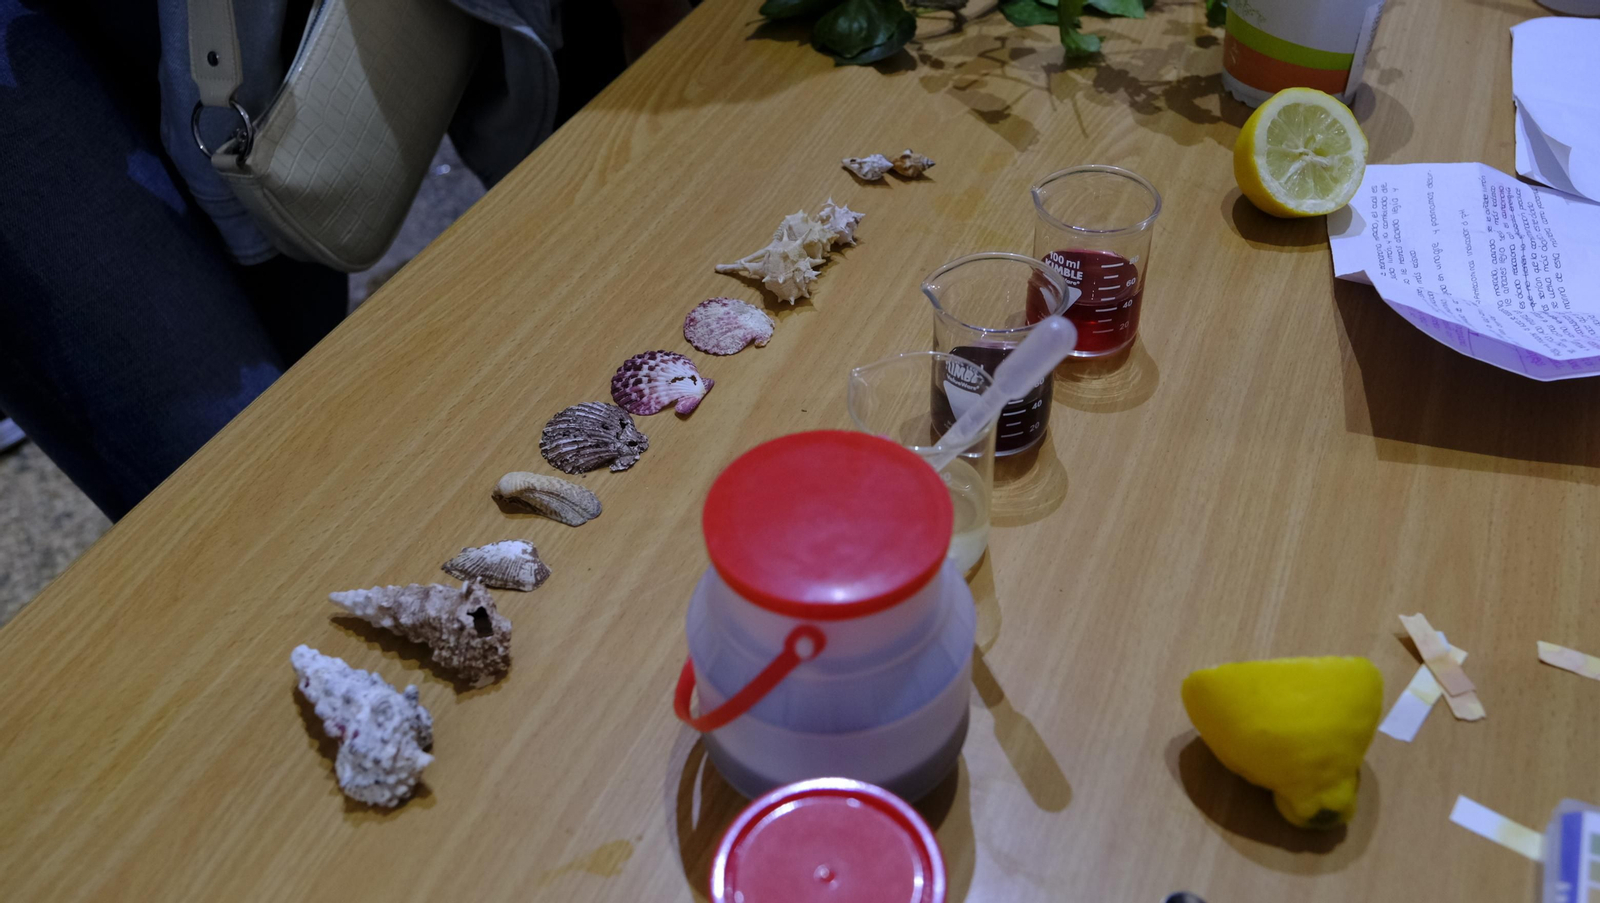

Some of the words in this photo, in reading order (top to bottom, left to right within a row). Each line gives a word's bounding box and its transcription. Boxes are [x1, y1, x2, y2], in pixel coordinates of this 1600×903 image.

[1049, 250, 1065, 264] 100
[1066, 260, 1081, 270] ml
[1045, 258, 1084, 281] KIMBLE
[1126, 277, 1137, 287] 60
[1123, 299, 1134, 309] 40
[1120, 320, 1130, 331] 20
[1032, 399, 1043, 410] 40
[1030, 421, 1040, 432] 20
